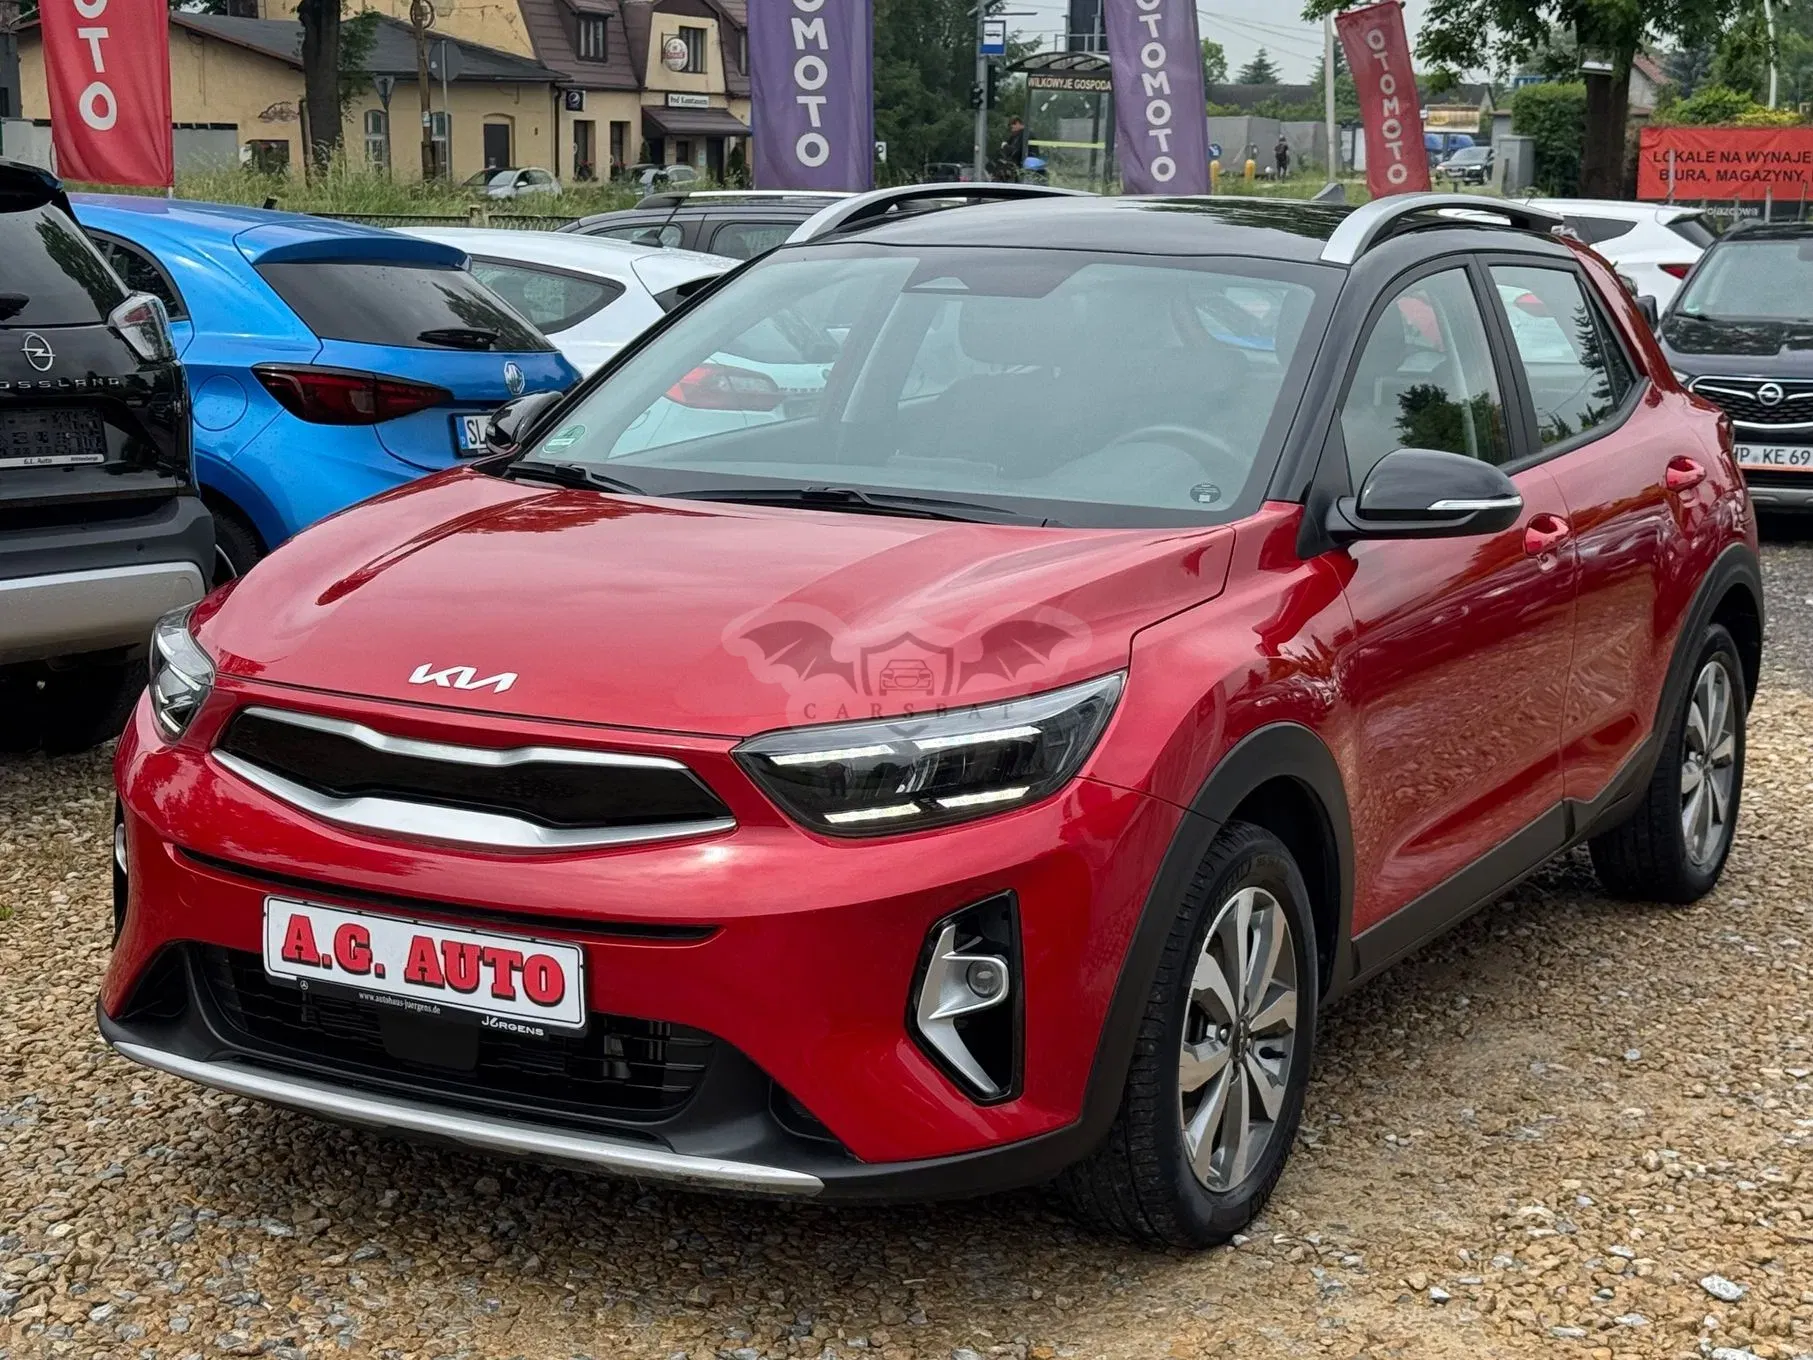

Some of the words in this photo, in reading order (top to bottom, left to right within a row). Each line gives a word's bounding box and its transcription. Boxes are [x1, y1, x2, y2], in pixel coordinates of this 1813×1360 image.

[1028, 77, 1073, 89] WILKOWYJE
[1366, 28, 1408, 185] OTOMOTO
[1720, 151, 1742, 164] NA
[1659, 168, 1711, 182] BURA,
[1716, 169, 1806, 183] MAGAZYNY,
[1763, 448, 1785, 465] KE
[1789, 450, 1811, 466] 69
[408, 662, 519, 694] KIA
[281, 913, 386, 980] A.G.
[404, 935, 566, 1007] AUTO
[358, 991, 441, 1015] www.autohaus-juergens.de
